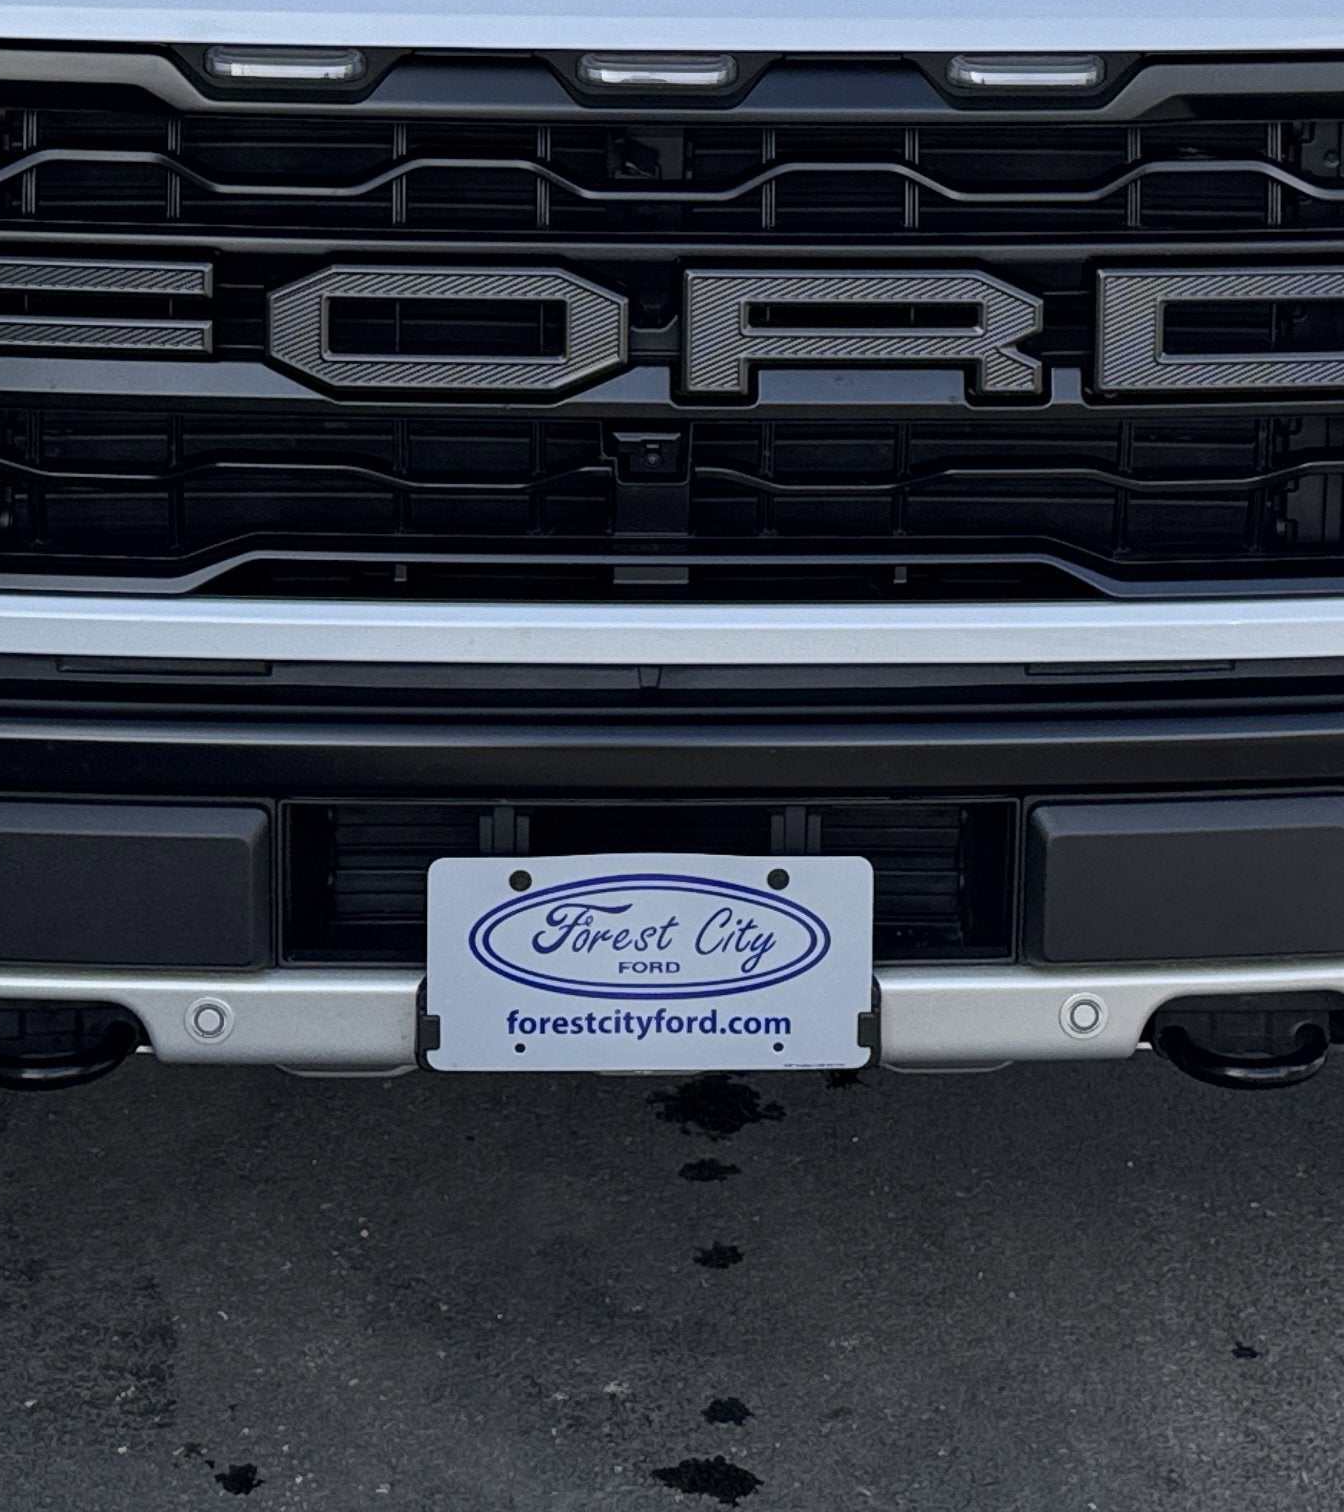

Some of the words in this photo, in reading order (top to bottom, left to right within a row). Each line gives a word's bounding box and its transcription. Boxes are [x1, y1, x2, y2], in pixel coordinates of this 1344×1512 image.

[531, 902, 680, 954] Forest
[694, 906, 777, 974] City
[617, 960, 681, 974] FORD
[506, 1007, 792, 1041] forestcityford.com
